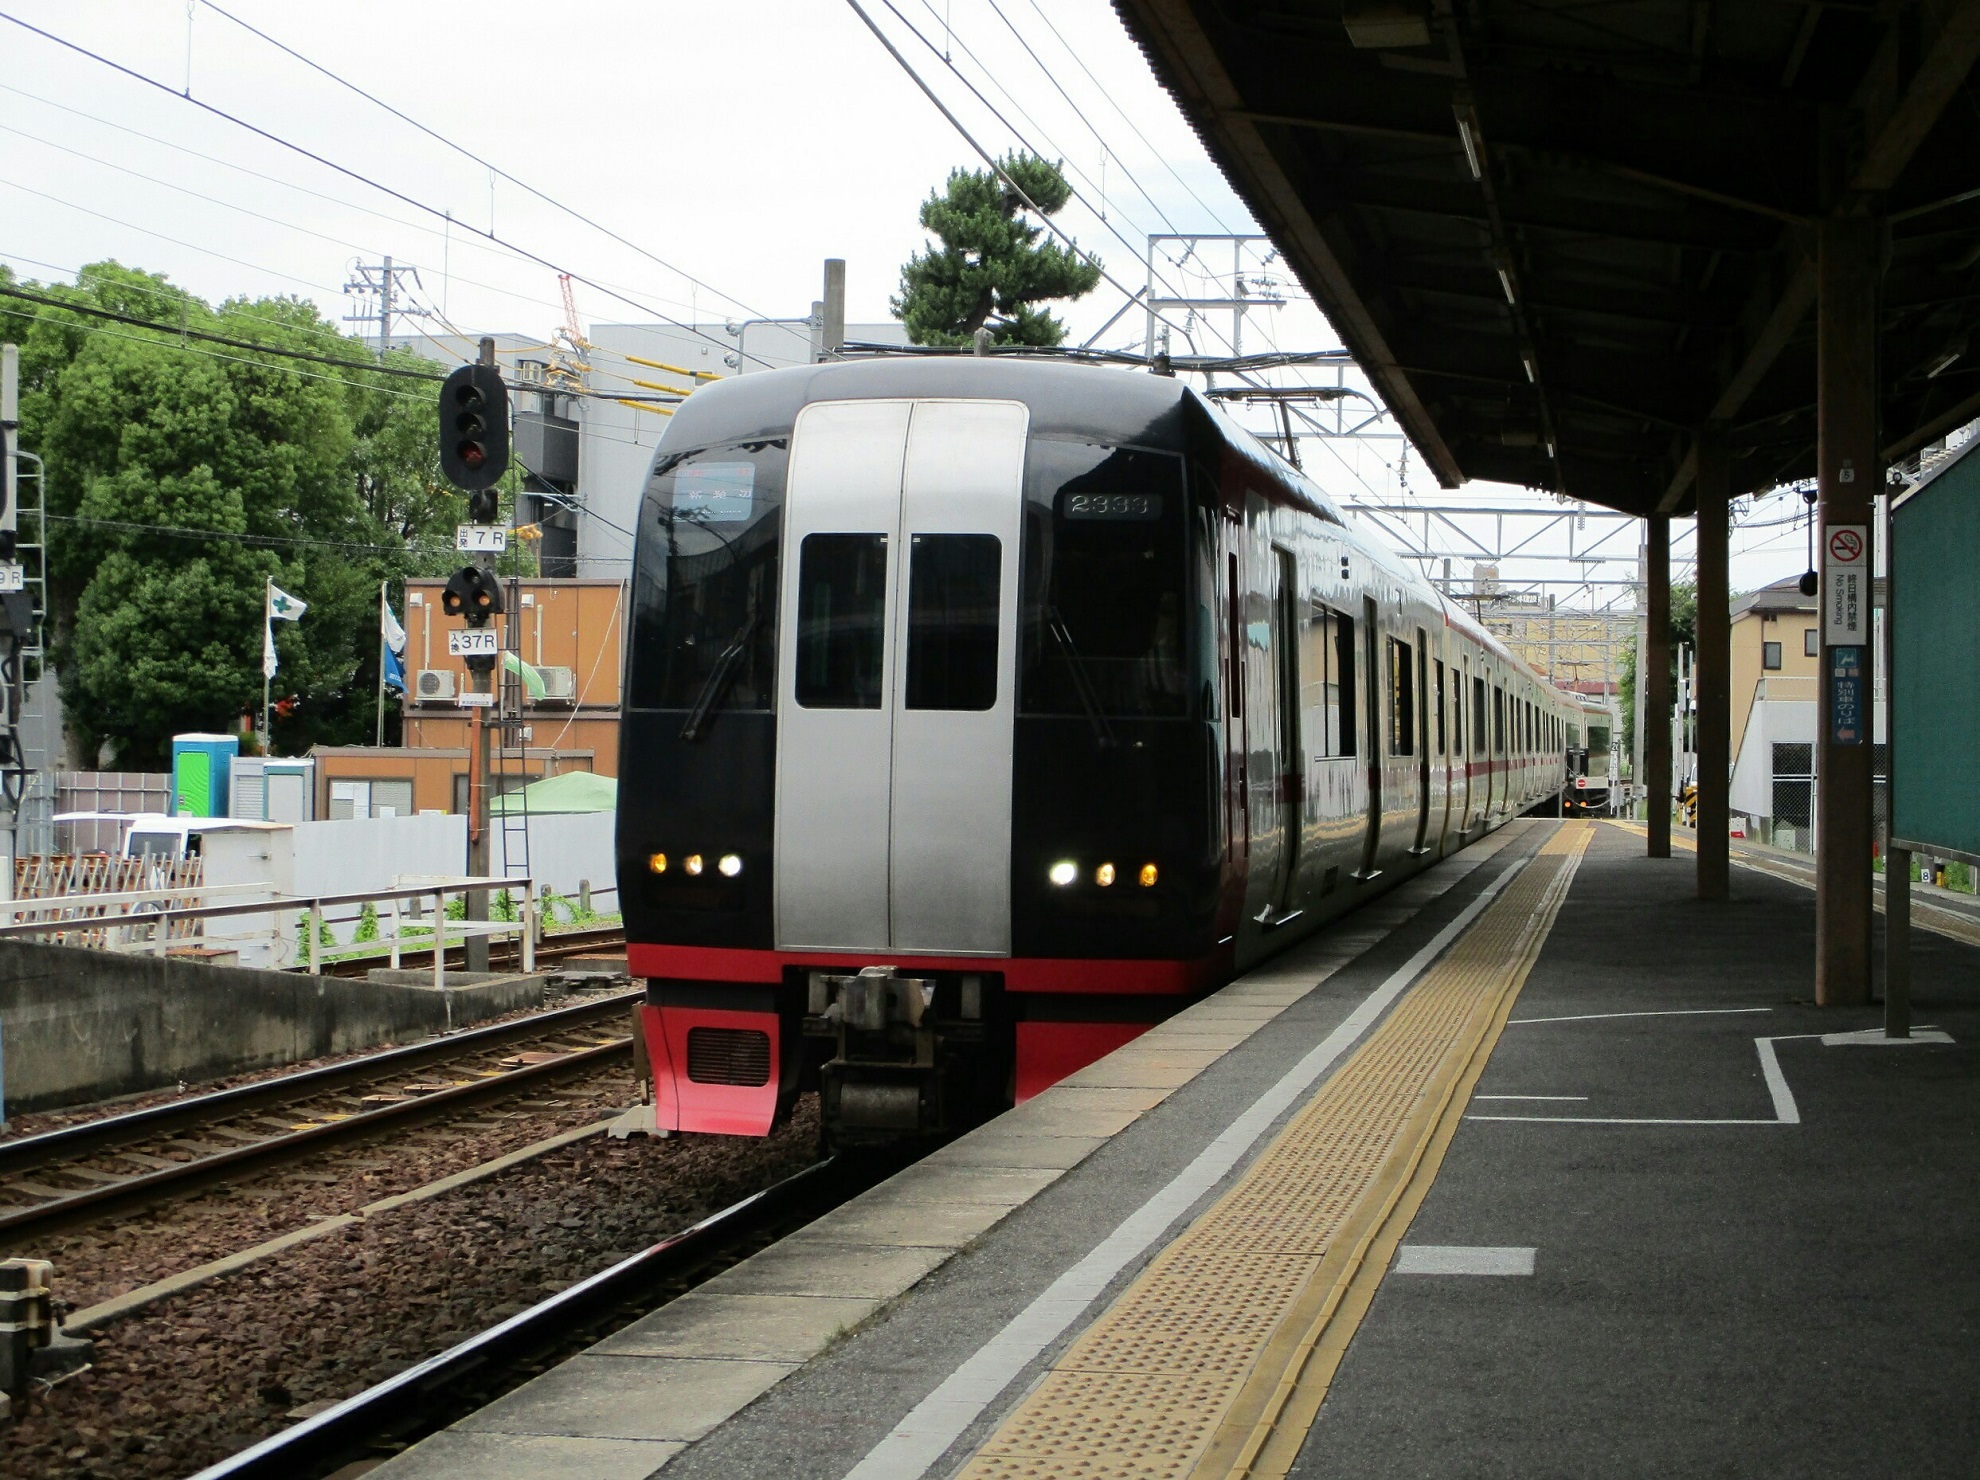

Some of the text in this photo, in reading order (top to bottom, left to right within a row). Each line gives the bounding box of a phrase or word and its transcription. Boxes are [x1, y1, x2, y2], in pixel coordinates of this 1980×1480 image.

[1071, 495, 1147, 514] 2333
[1834, 574, 1844, 626] No Smoking
[461, 635, 494, 649] 37R
[1922, 871, 1929, 881] 8
